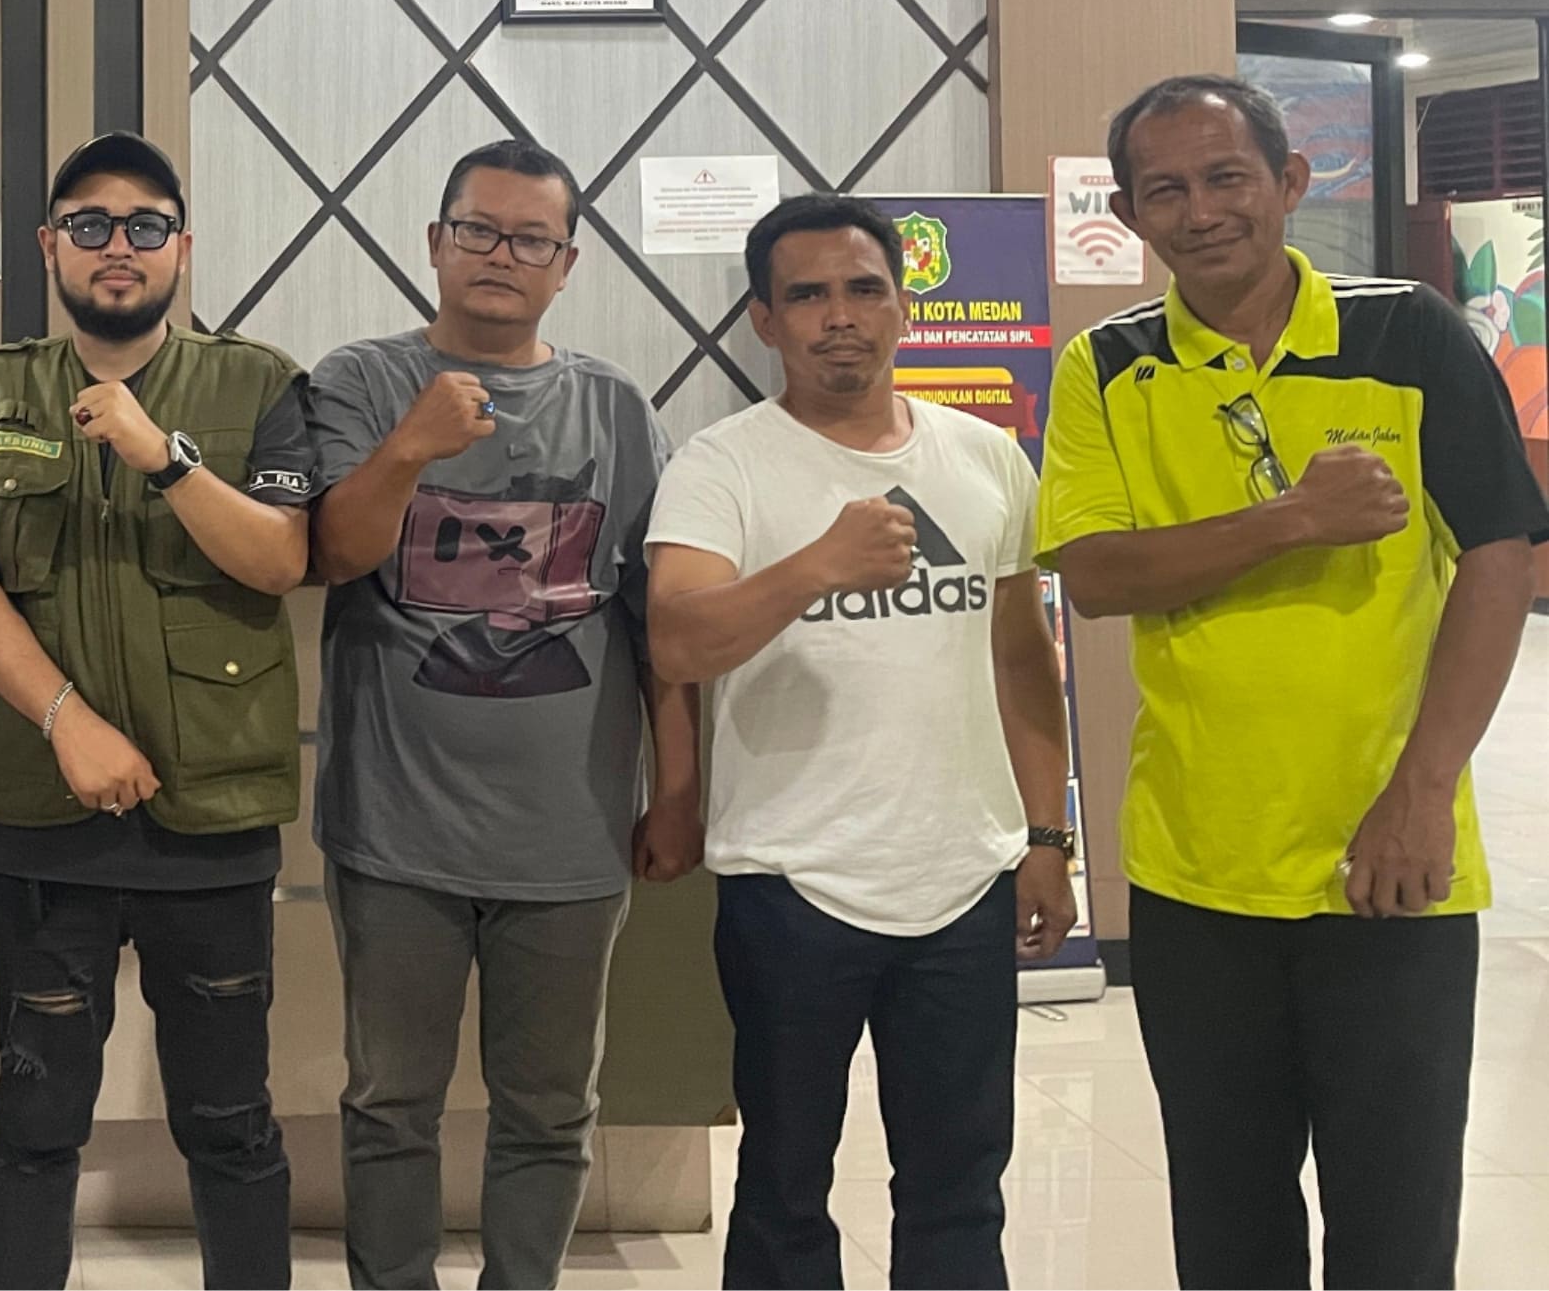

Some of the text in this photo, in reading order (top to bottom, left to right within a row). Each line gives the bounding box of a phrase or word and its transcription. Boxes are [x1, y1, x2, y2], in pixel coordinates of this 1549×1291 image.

[923, 301, 966, 322] KOTA
[968, 301, 1022, 322] MEDAN
[925, 331, 943, 344] DAN
[945, 330, 1008, 345] PENCATATAN
[1009, 330, 1034, 344] SIPIL
[975, 390, 1014, 405] DIGITAL
[276, 473, 299, 488] FILA
